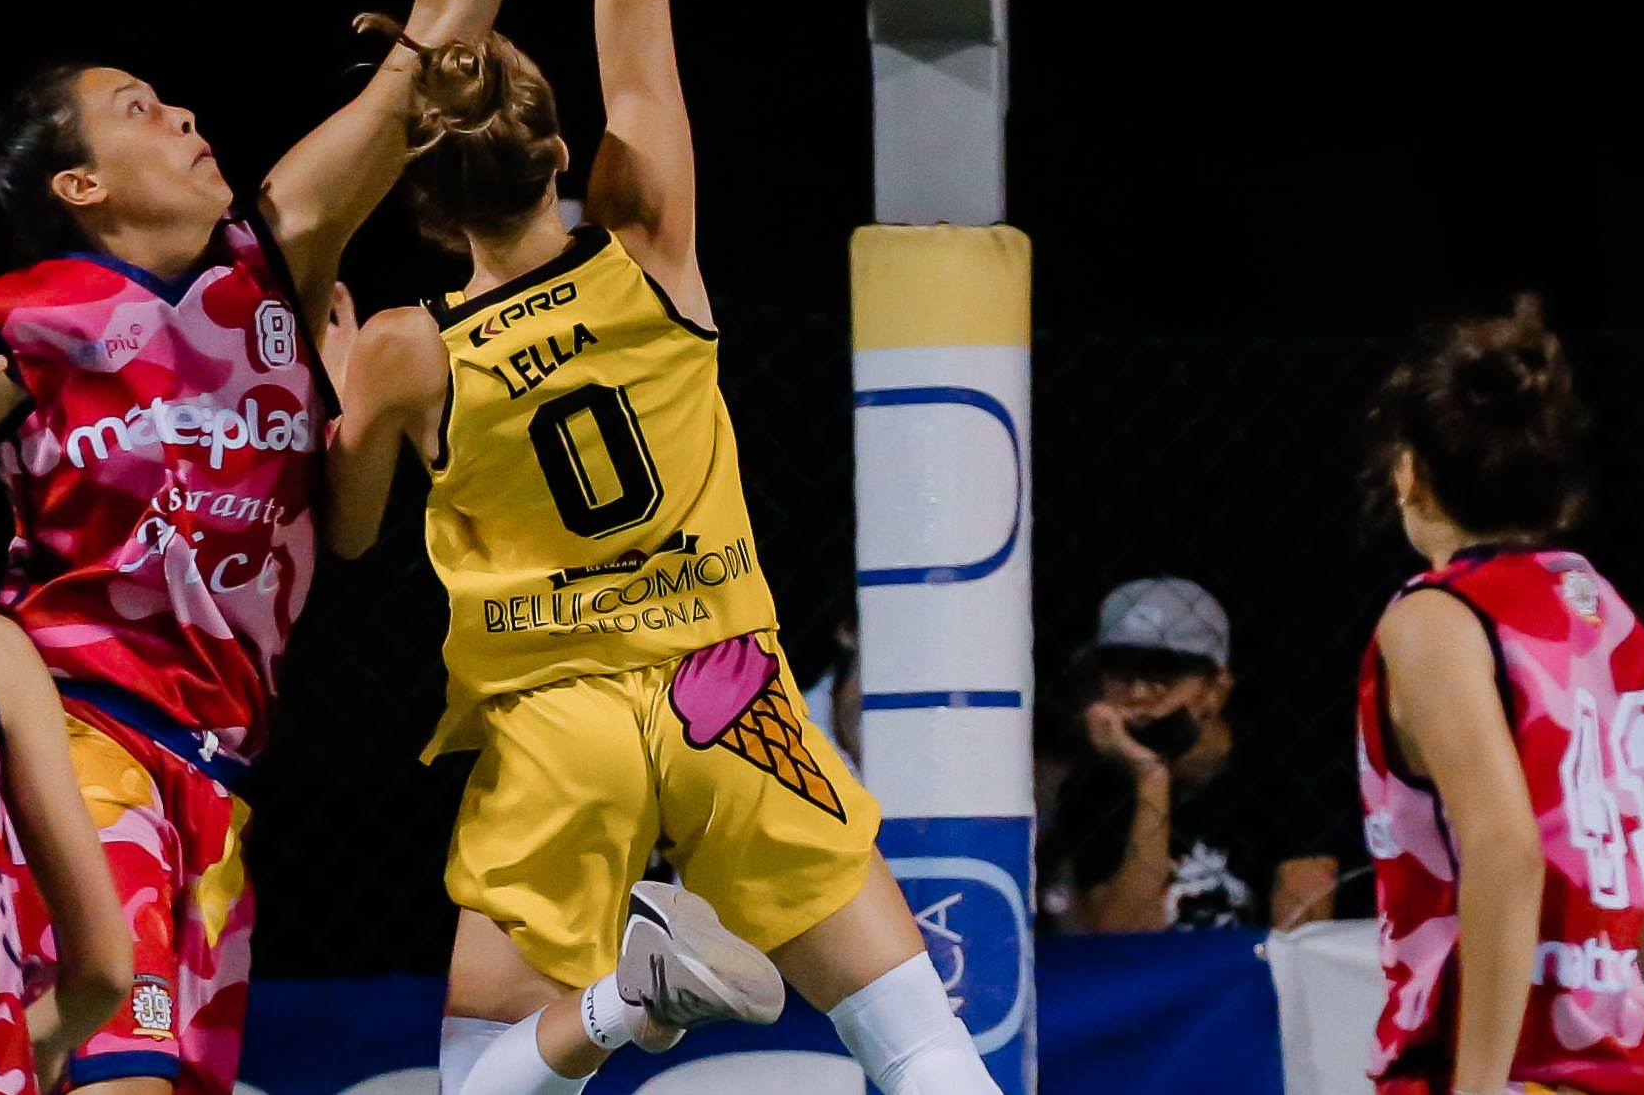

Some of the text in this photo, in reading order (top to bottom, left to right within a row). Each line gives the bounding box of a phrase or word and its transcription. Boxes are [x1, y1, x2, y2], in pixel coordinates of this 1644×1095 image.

[255, 299, 297, 370] 8
[491, 322, 599, 400] LELLA
[528, 383, 665, 540] 0
[483, 537, 753, 633] BELLI COMODI
[570, 597, 712, 635] OLOGNA
